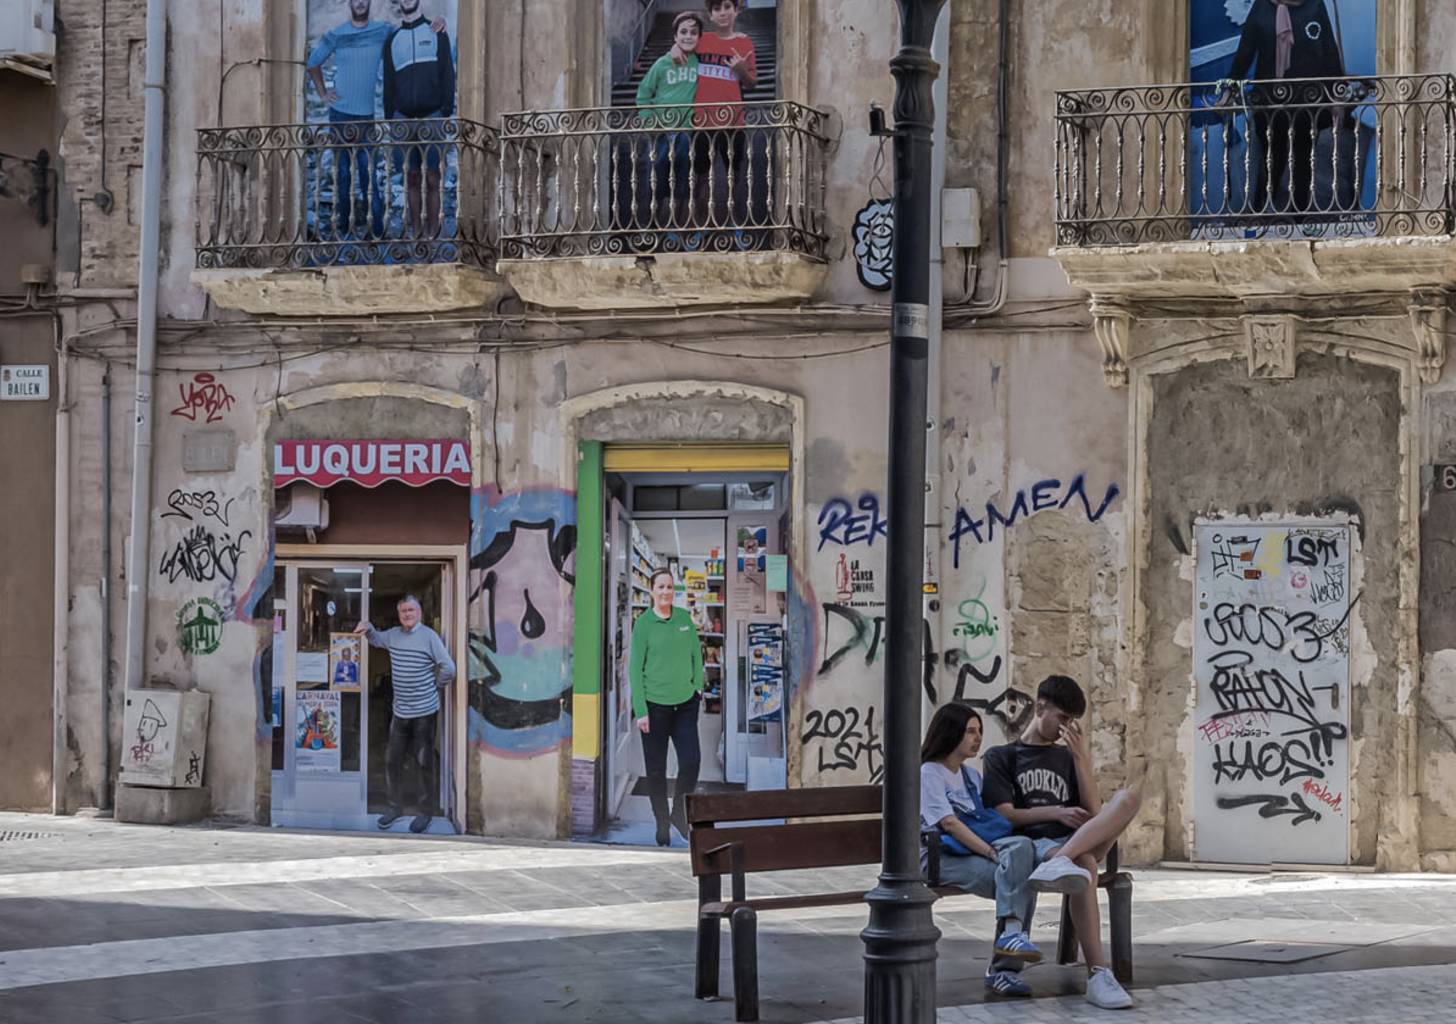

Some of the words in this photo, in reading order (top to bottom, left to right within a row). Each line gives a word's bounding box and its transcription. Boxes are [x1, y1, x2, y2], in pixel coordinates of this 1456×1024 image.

[16, 369, 43, 378] CALLE
[7, 382, 40, 396] BAILEN
[274, 443, 471, 476] LUQUERIA
[948, 472, 1121, 570] AMEN
